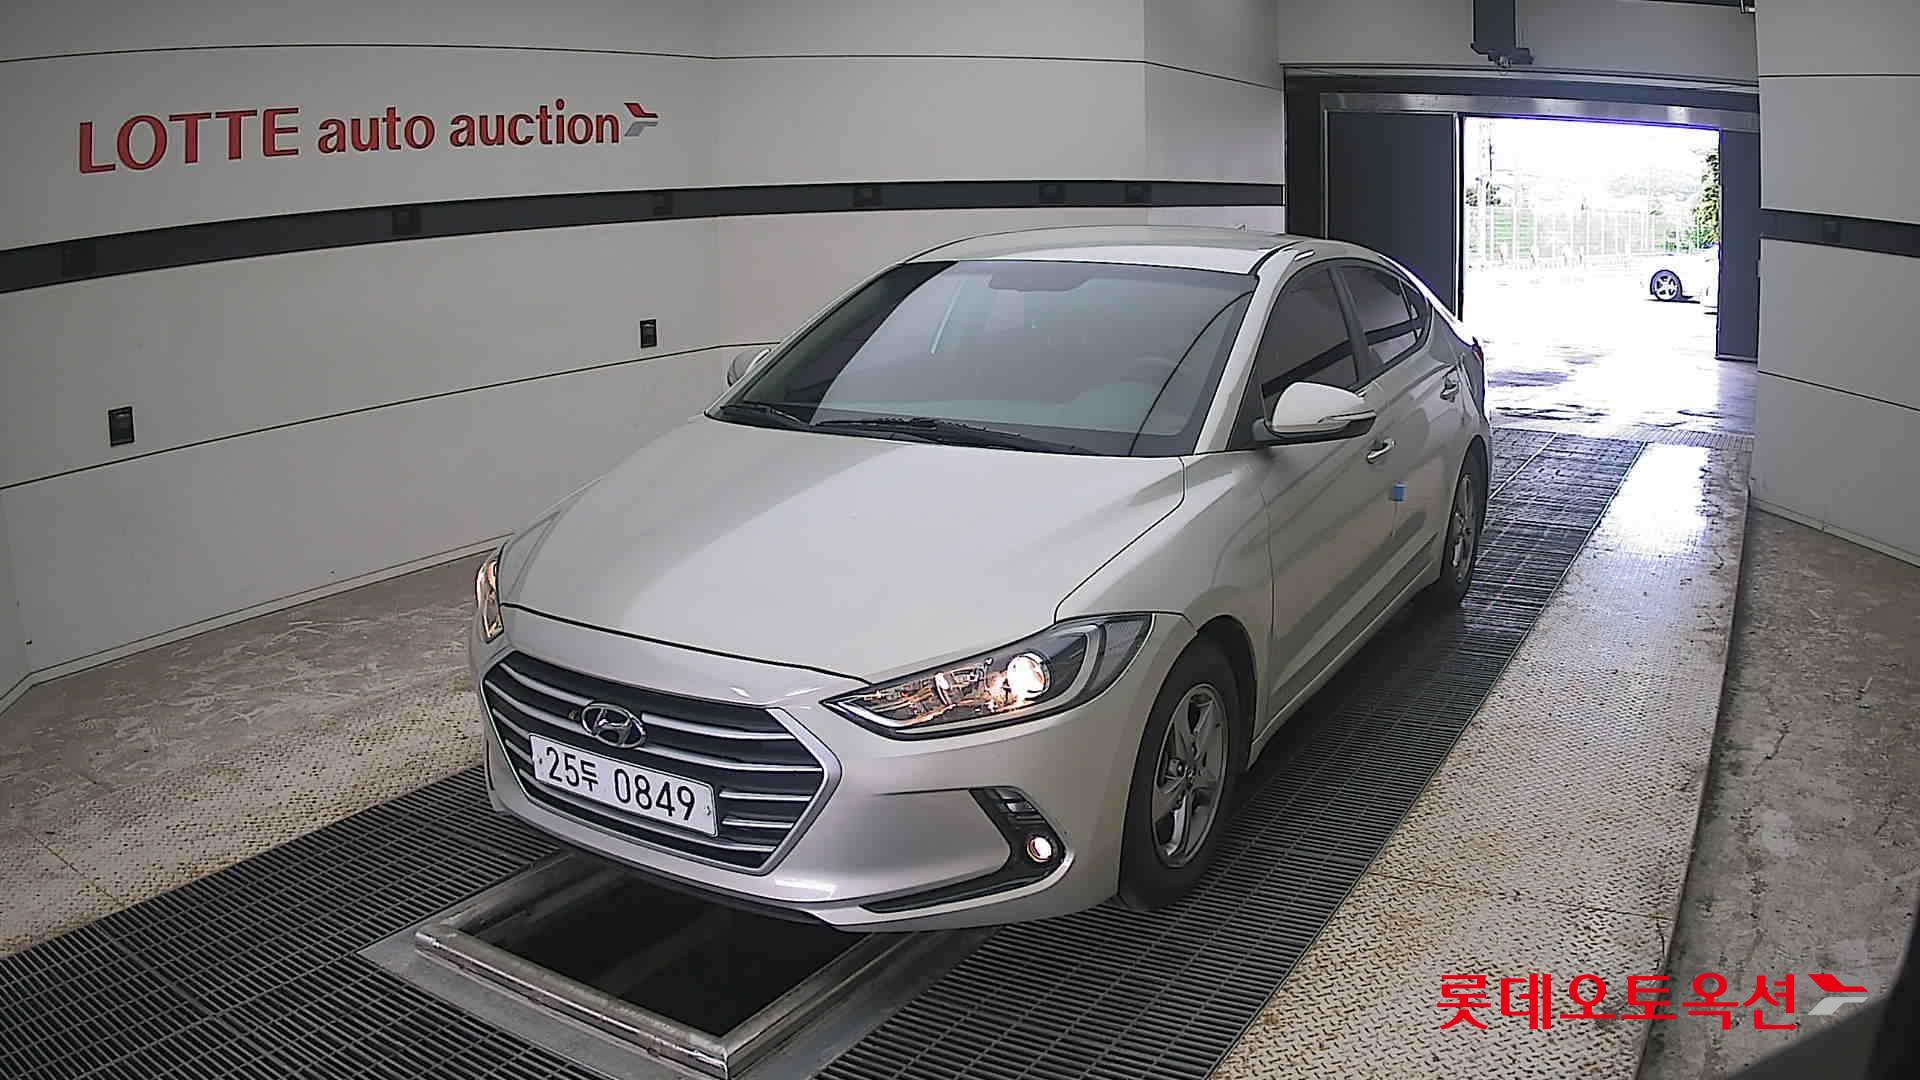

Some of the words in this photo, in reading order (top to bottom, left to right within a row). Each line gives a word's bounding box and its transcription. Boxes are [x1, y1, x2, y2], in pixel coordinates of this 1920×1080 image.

[78, 106, 301, 174] LOTTE
[317, 105, 436, 154] auto
[449, 98, 621, 149] auction
[546, 746, 599, 792] 25두
[613, 768, 696, 821] 0849
